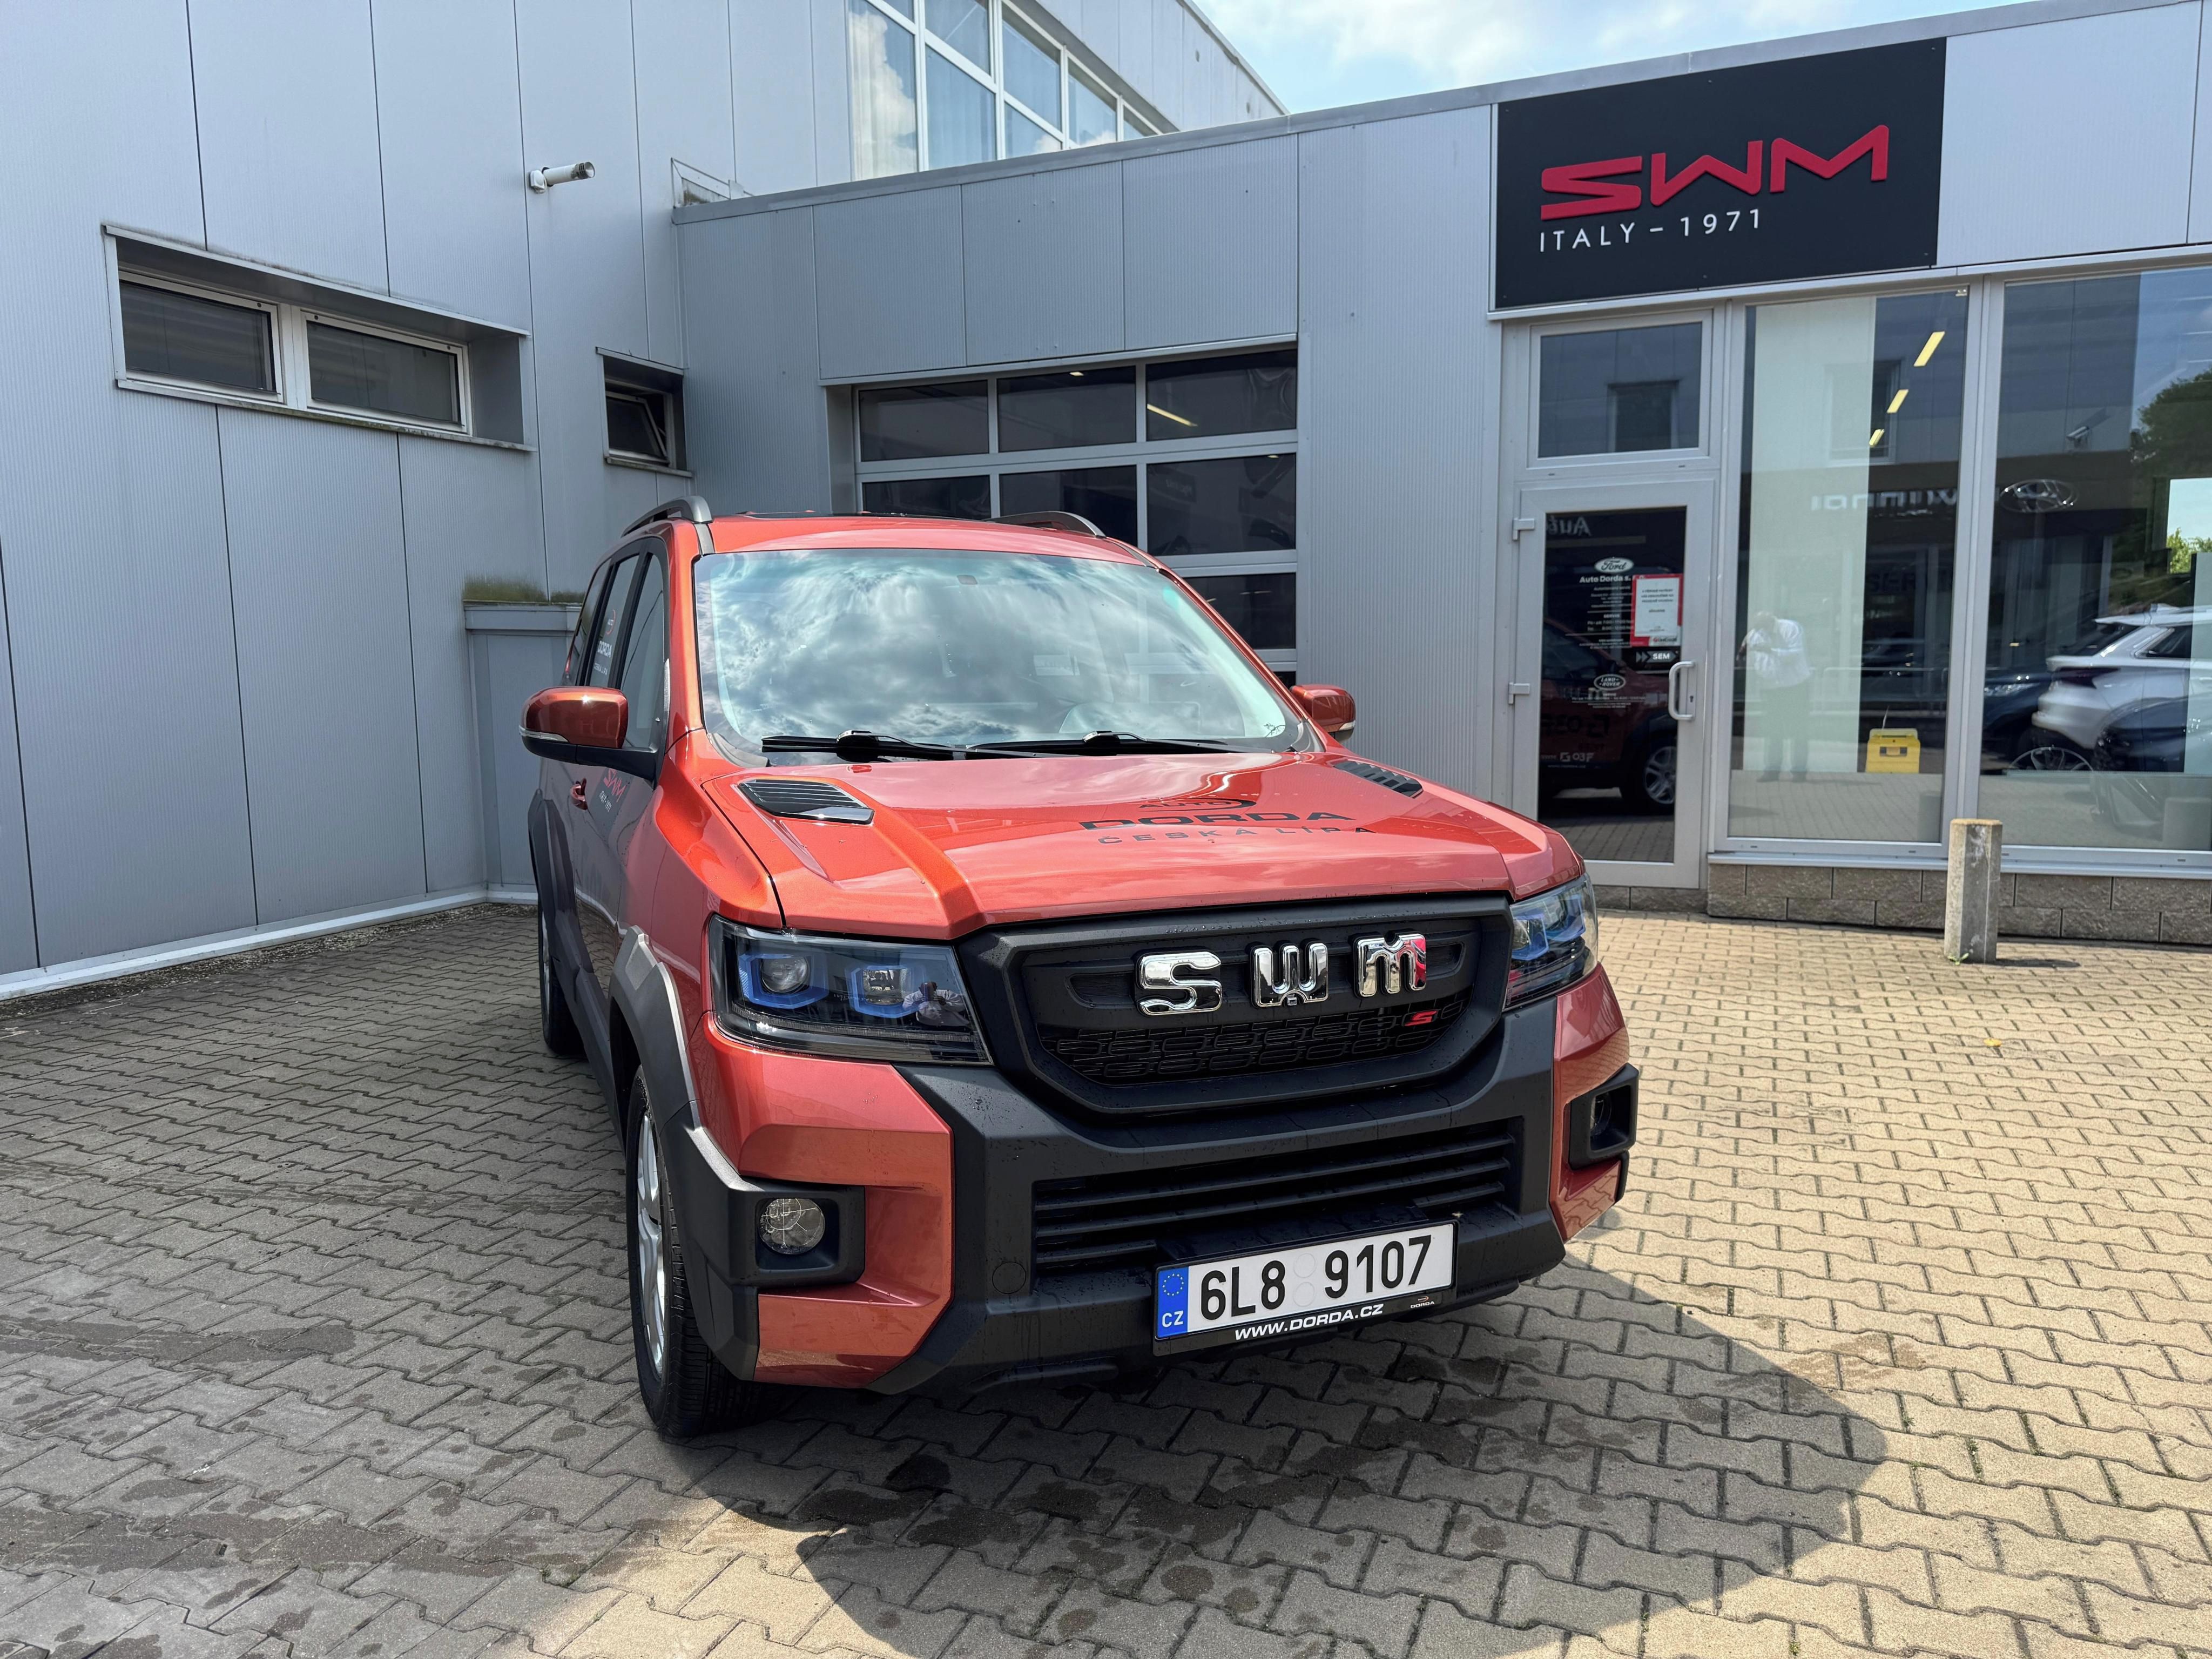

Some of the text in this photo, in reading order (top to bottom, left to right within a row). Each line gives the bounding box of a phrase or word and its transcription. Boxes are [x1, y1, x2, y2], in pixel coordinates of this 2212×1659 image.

[1540, 124, 1889, 220] SWM
[1540, 221, 1636, 252] ITALY
[1680, 208, 1760, 237] 1971
[1601, 559, 1627, 571] Ford
[1078, 812, 1357, 831] DORDA
[1137, 932, 1427, 1017] SWM
[1200, 1235, 1432, 1321] 6L8 9107
[1161, 1310, 1184, 1328] CZ
[1234, 1303, 1384, 1341] WWW.DORDA.CZ
[1410, 1300, 1435, 1309] DORDA
